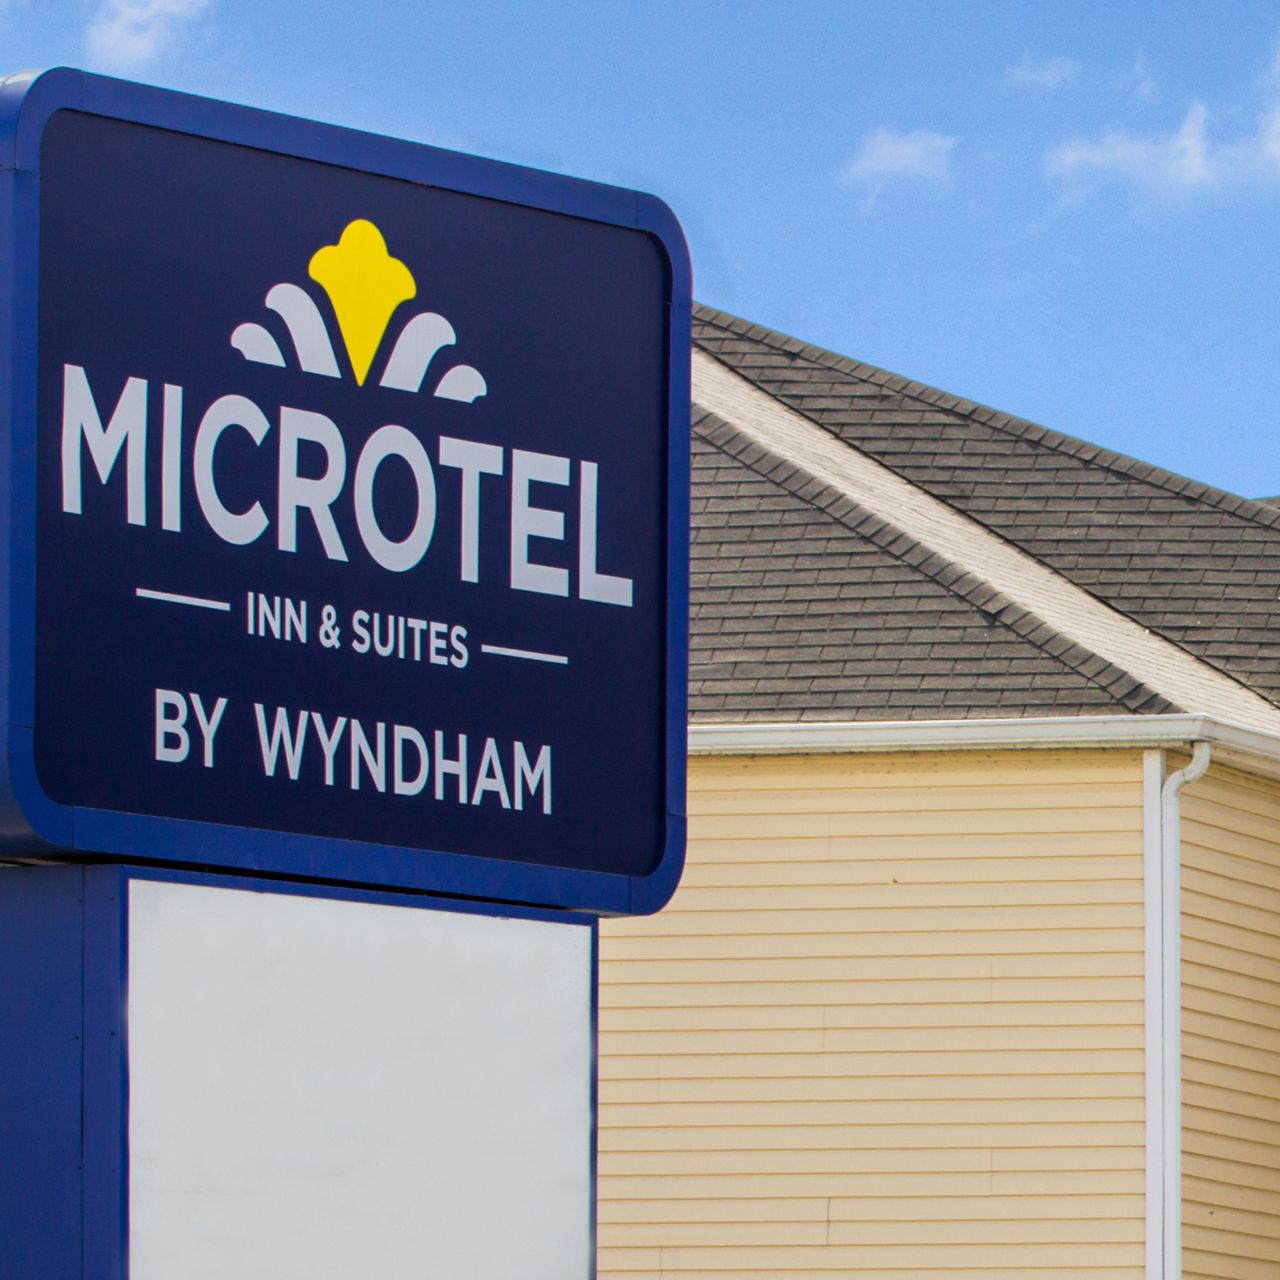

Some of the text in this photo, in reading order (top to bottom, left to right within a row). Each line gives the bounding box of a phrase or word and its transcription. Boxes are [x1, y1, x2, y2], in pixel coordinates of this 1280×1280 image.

[61, 363, 633, 607] MICROTEL
[247, 591, 469, 668] INN & SUITES
[155, 688, 551, 815] BY WYNDHAM
